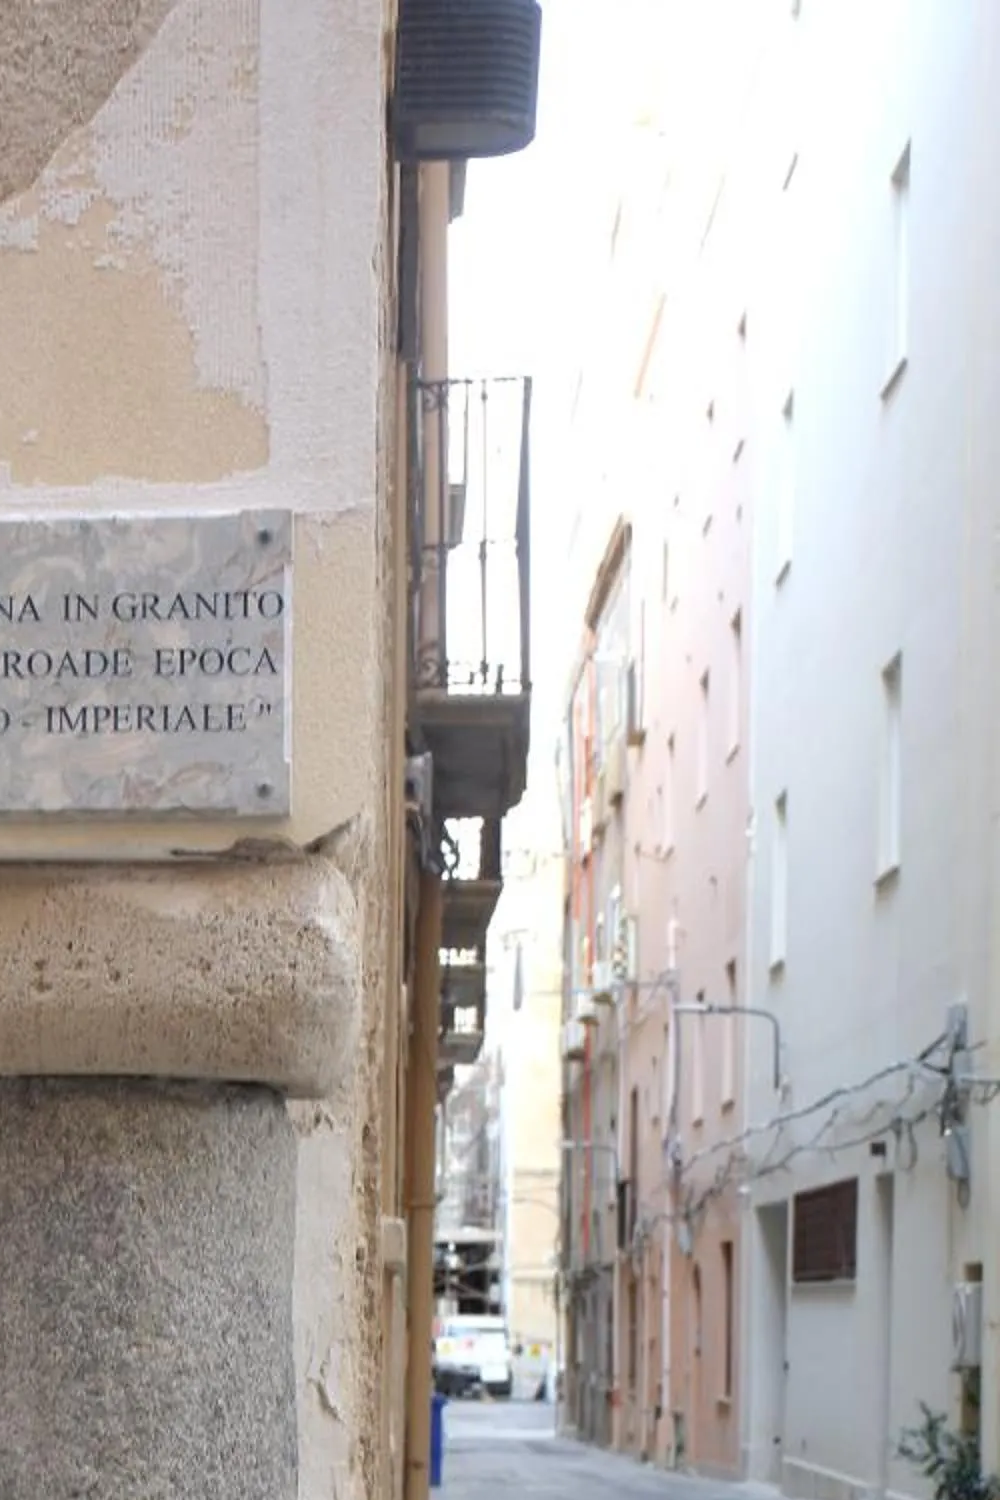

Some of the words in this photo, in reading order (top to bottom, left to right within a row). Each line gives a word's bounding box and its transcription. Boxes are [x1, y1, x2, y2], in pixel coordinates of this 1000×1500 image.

[63, 593, 98, 621] IN
[112, 590, 285, 623] GRANITO
[154, 647, 278, 676] EPOCA
